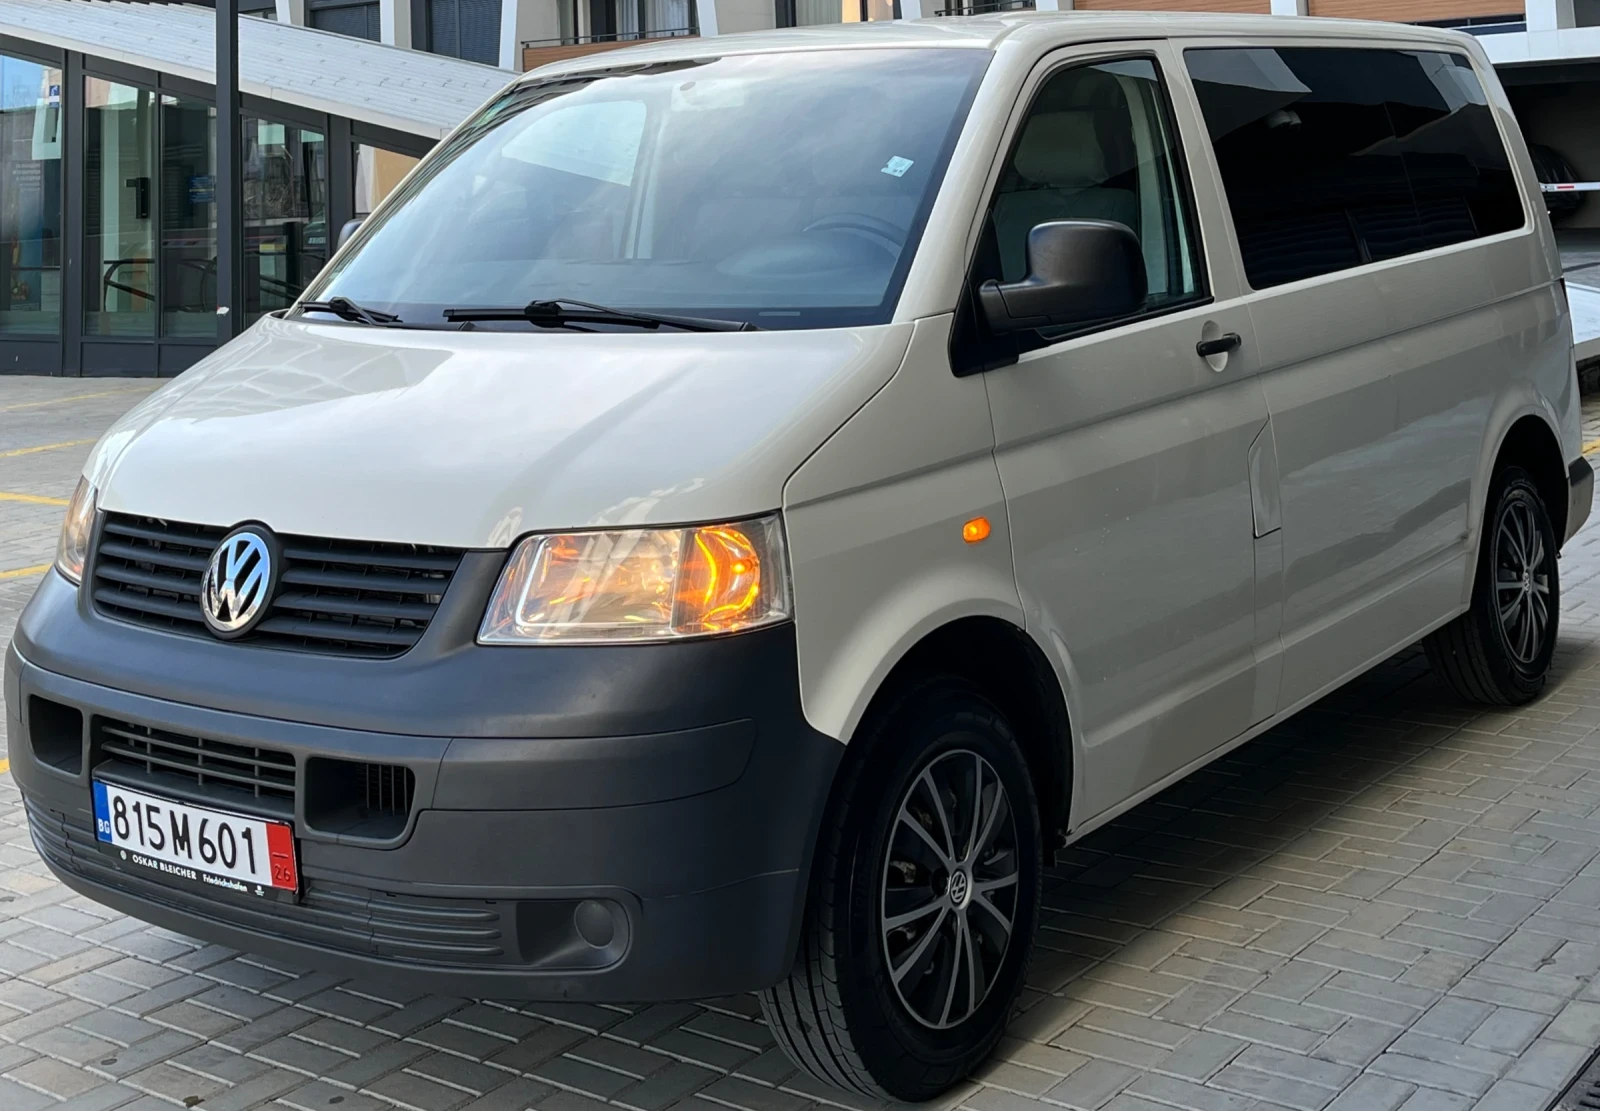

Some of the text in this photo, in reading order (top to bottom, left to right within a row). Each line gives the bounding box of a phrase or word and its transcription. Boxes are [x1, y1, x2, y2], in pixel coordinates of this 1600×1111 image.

[98, 818, 111, 834] BG
[112, 795, 256, 874] 815M601
[132, 854, 248, 892] OSKAR BLEICHER Friedrichshafen
[274, 864, 291, 882] 26
